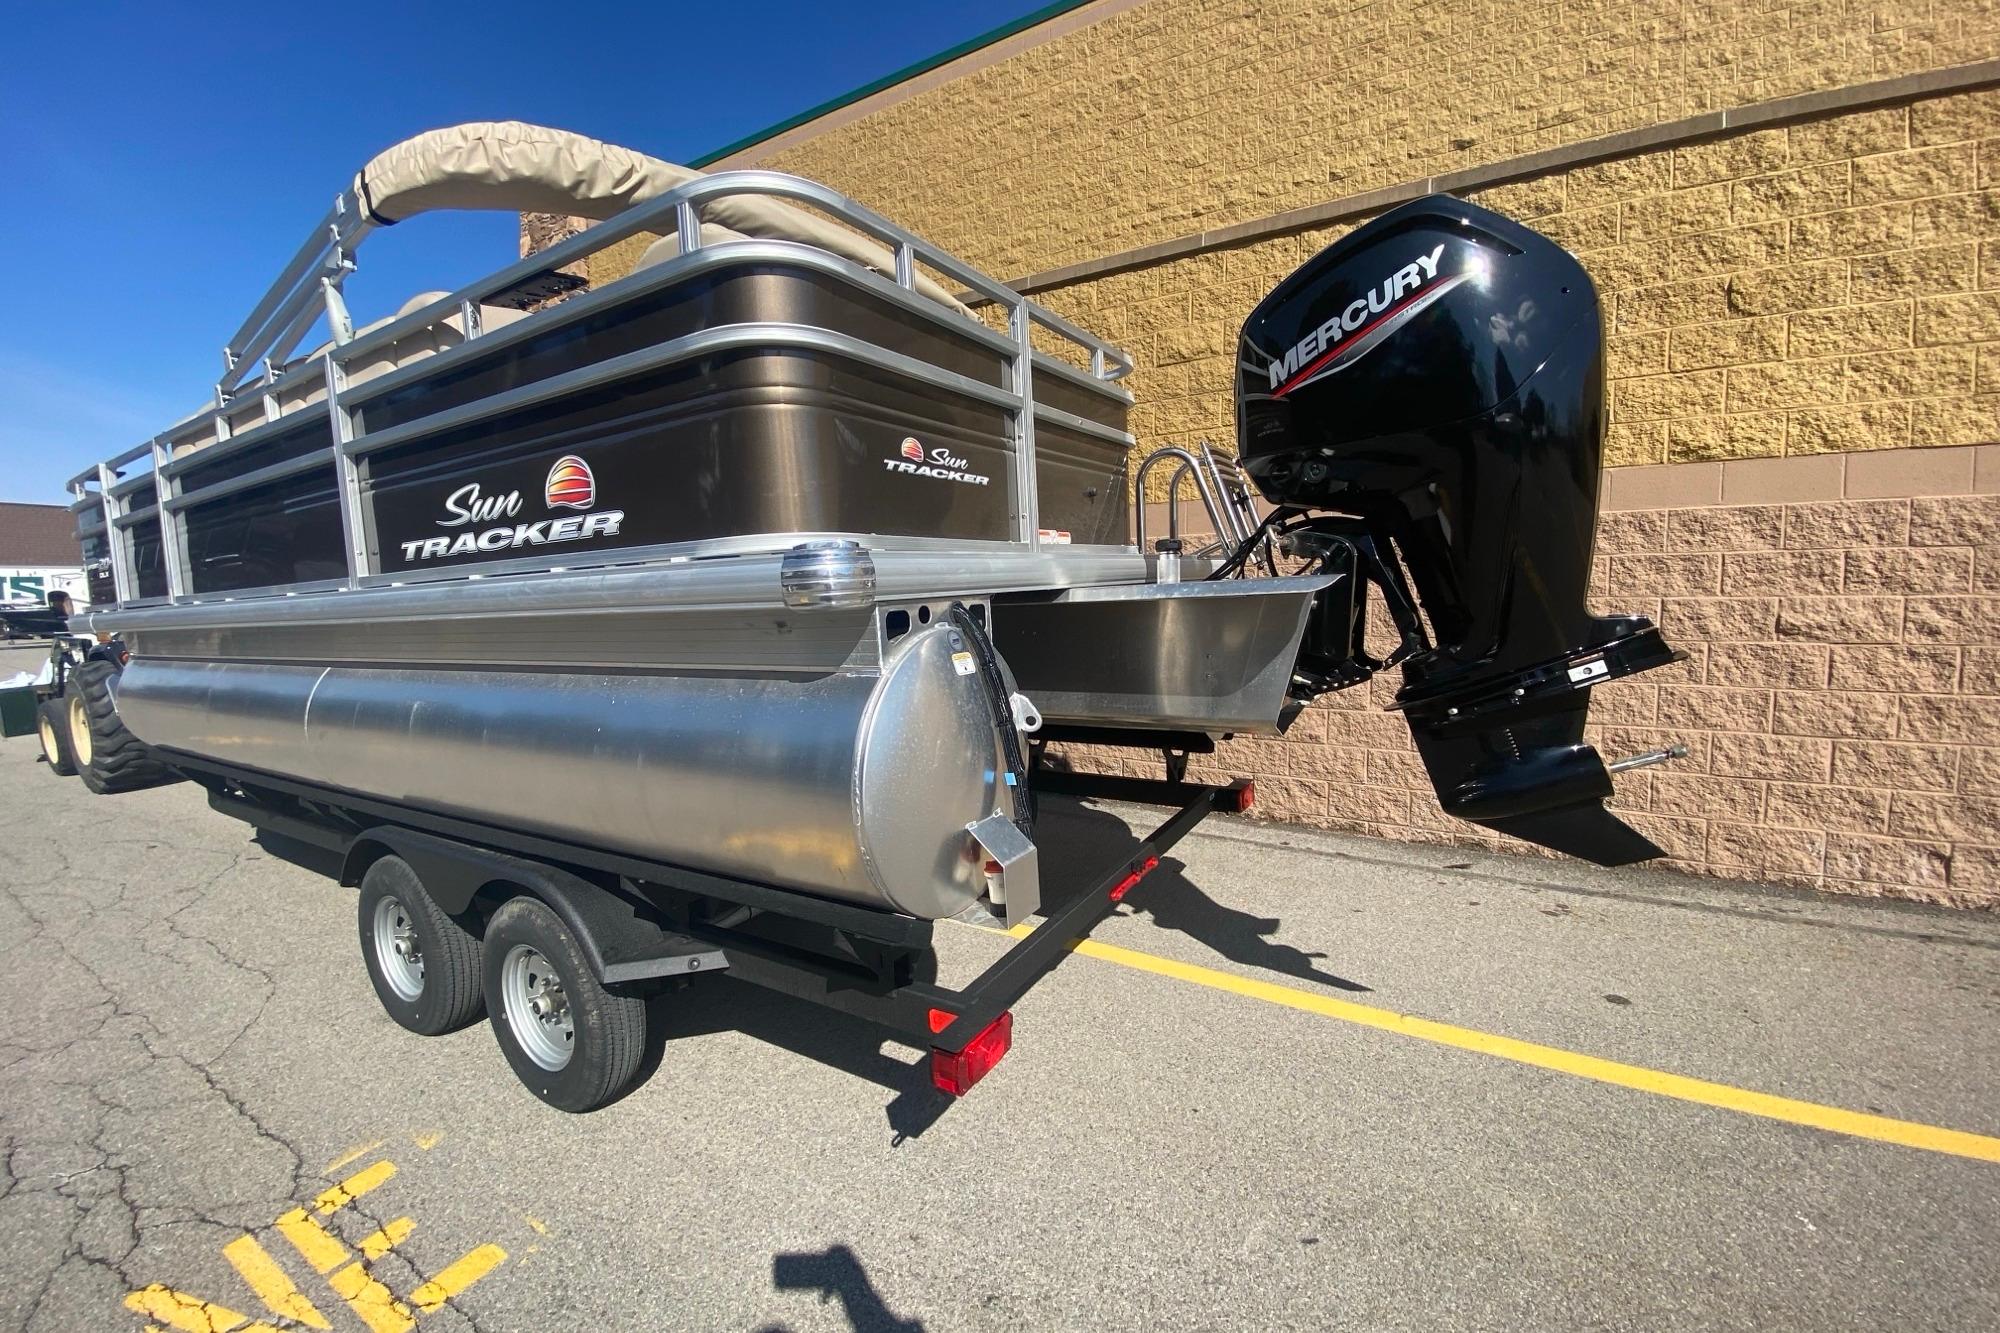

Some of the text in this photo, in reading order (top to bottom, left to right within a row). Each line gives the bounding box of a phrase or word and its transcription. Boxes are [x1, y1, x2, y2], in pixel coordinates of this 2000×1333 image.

[1267, 243, 1446, 391] MERCURY
[883, 458, 990, 486] TRACKER
[926, 448, 969, 471] Sun
[435, 482, 524, 527] Sun
[401, 509, 625, 562] TRACKER
